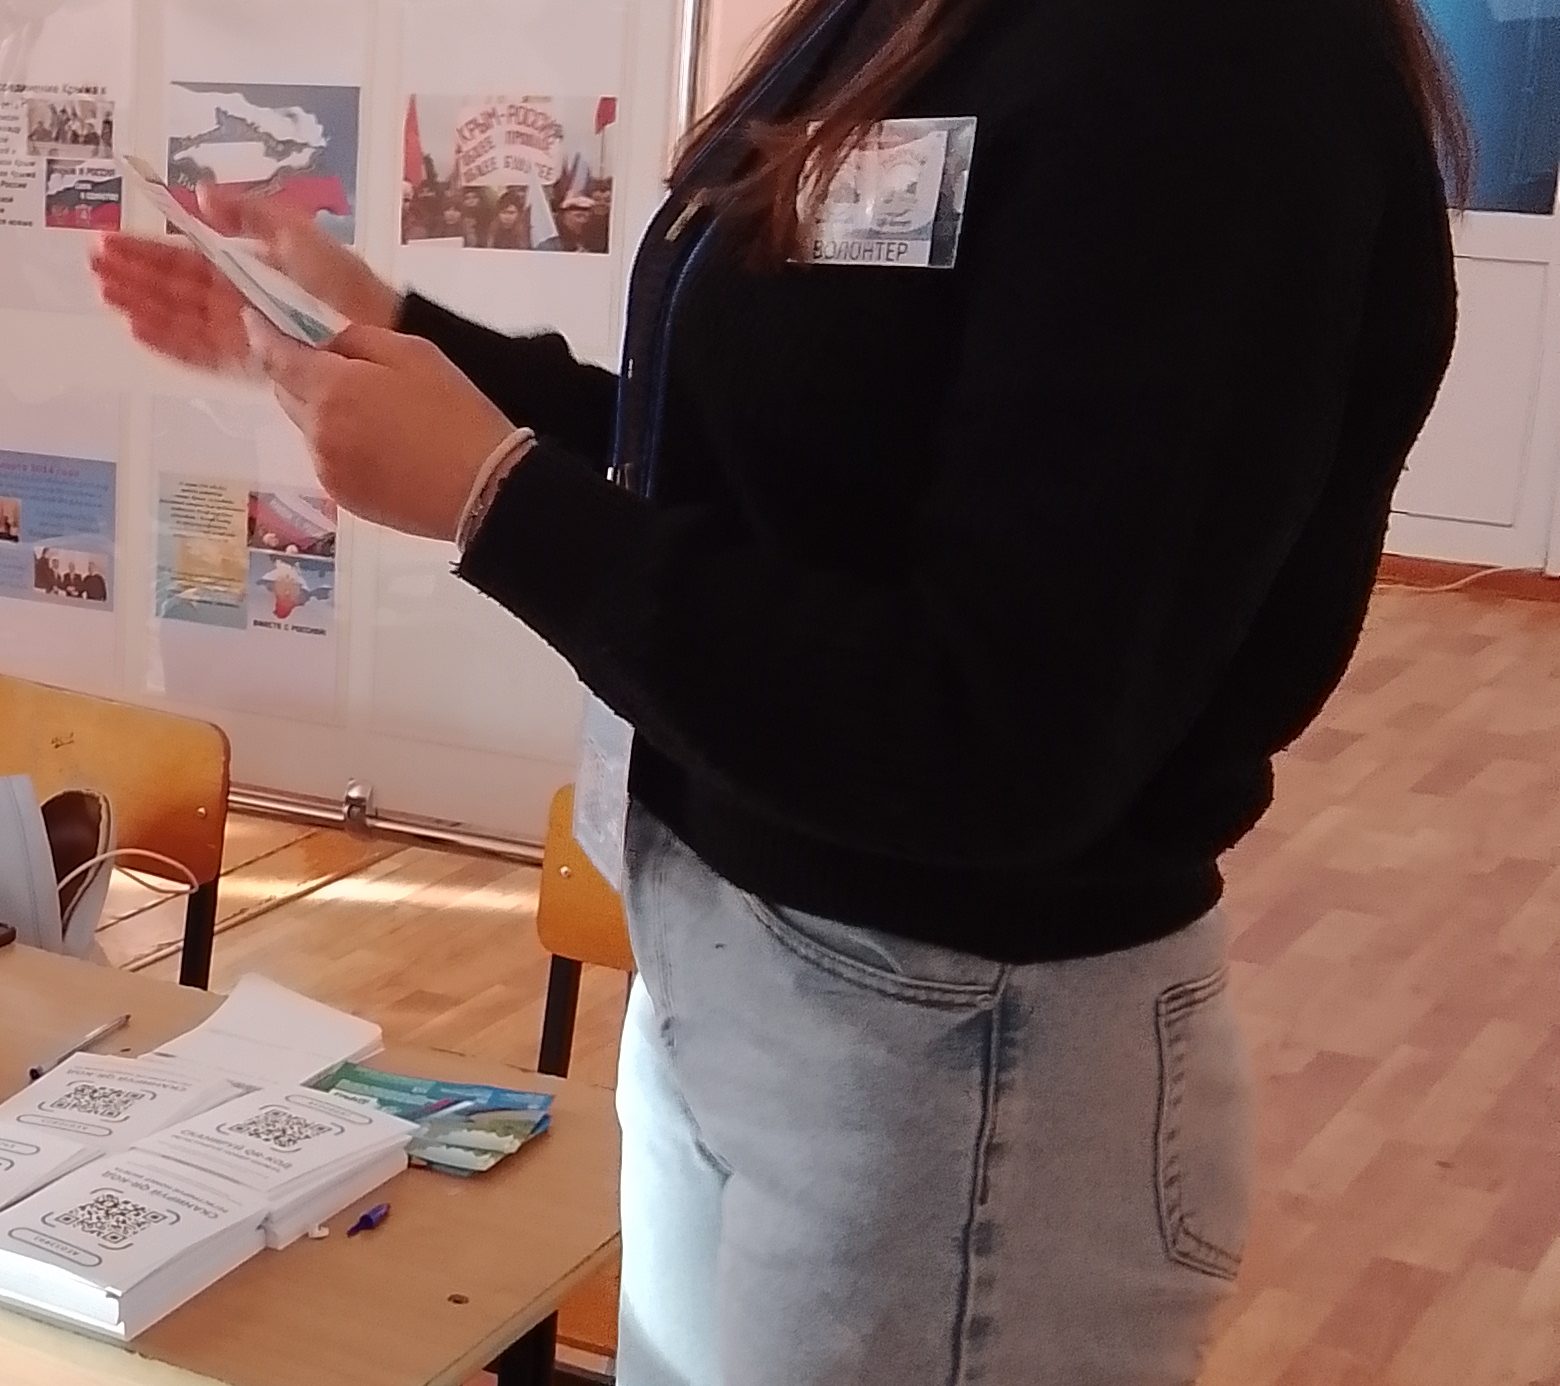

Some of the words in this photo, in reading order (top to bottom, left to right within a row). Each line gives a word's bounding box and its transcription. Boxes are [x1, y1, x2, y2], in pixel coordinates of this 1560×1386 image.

[812, 239, 909, 262] ВОЛОНТЕР
[101, 1169, 152, 1193] QR-КОД
[150, 1187, 220, 1220] СКАНИРУЙ
